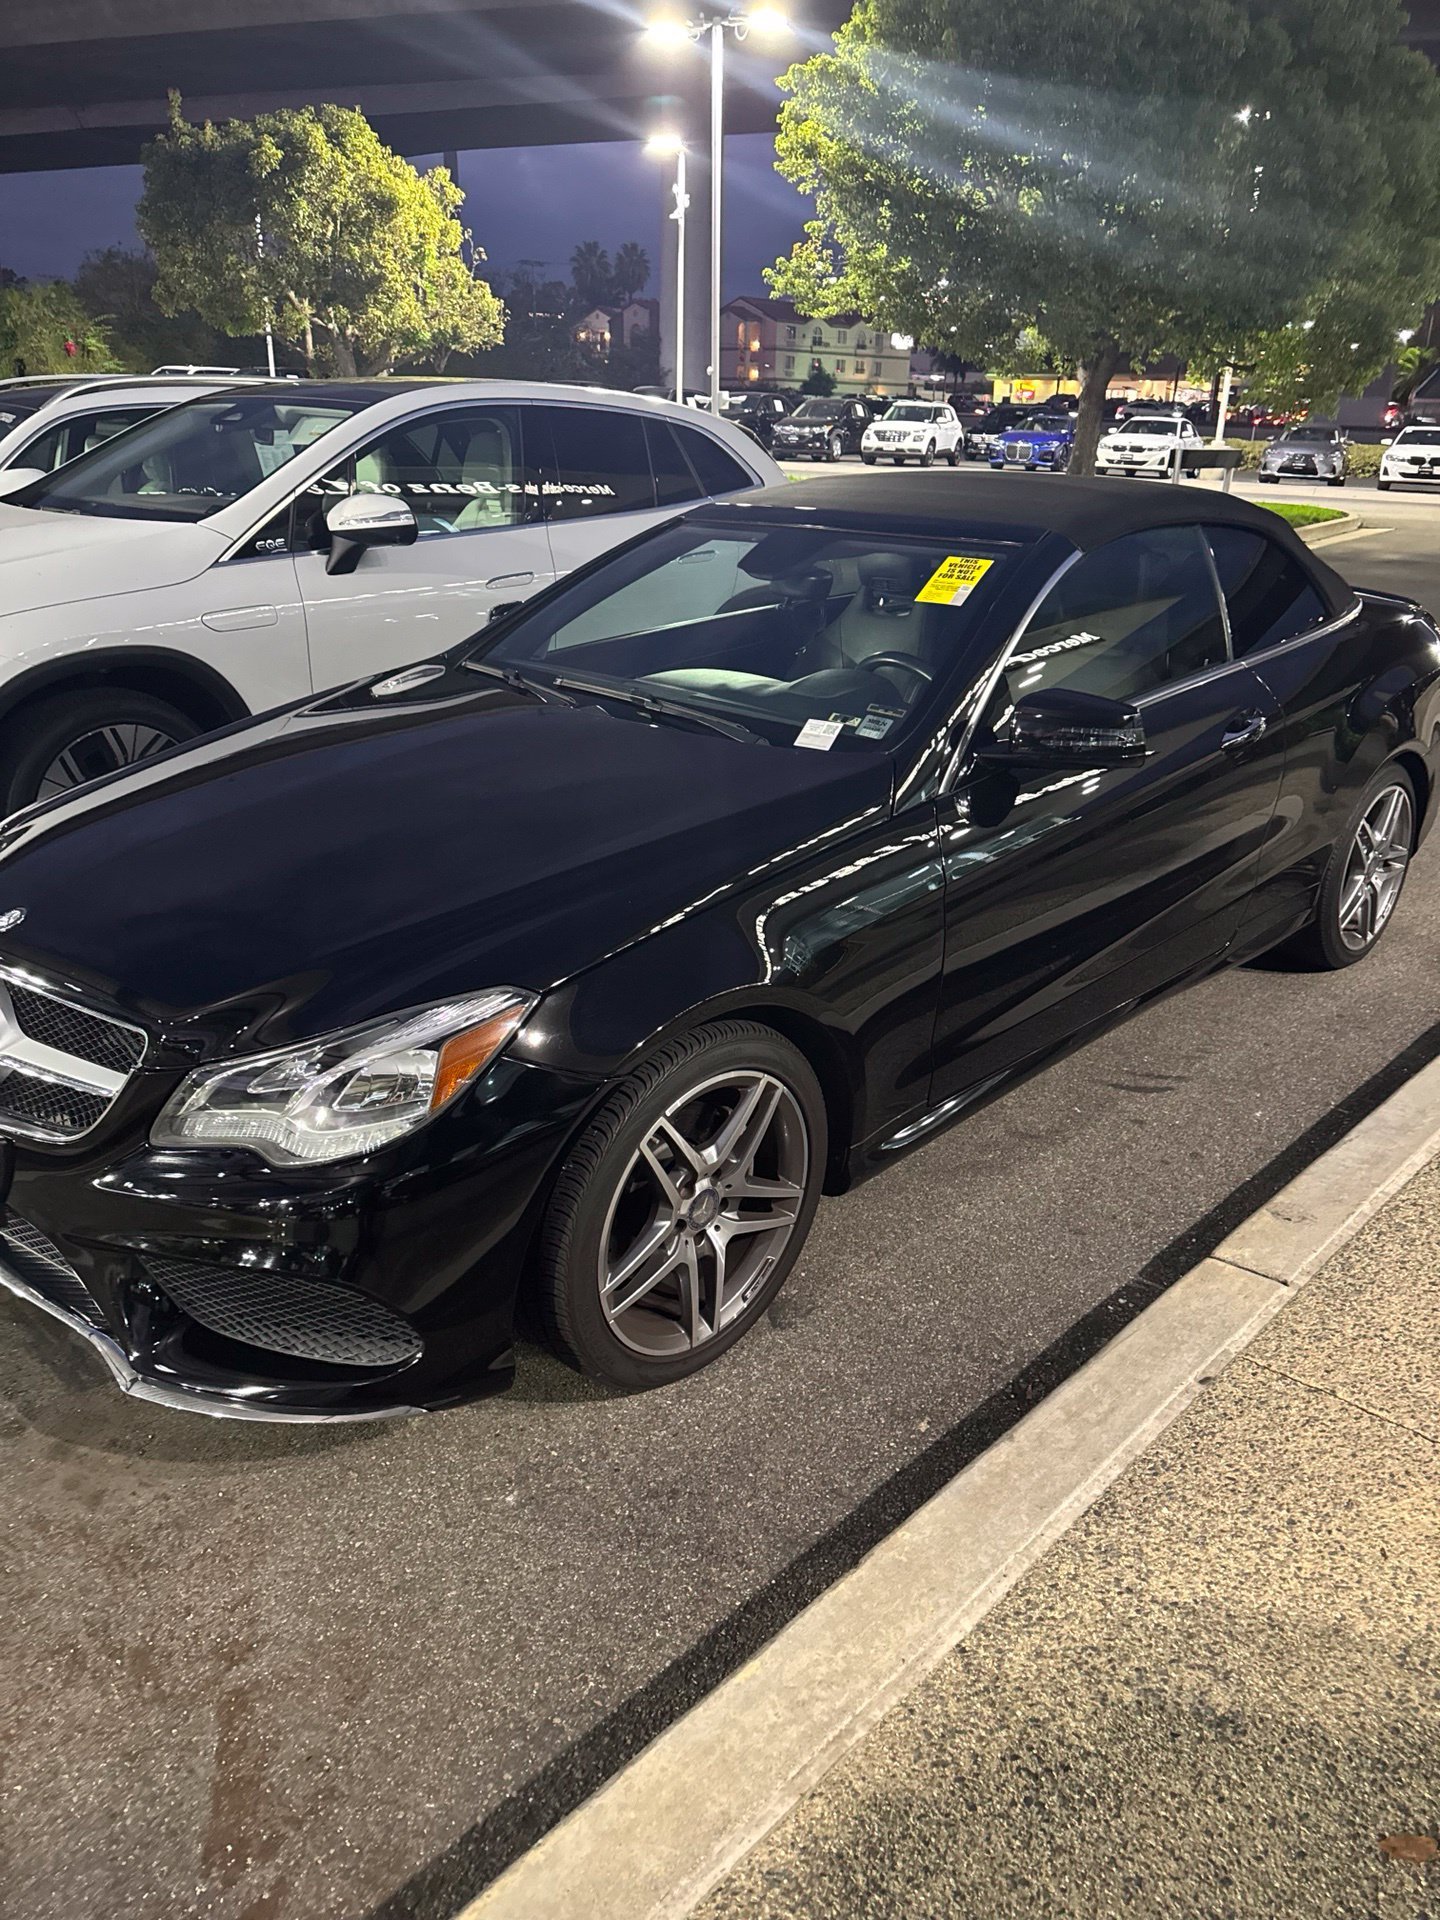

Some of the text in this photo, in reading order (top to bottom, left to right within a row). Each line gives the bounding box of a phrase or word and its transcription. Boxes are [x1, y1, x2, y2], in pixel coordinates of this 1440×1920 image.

[255, 538, 286, 551] EQE
[948, 562, 983, 571] VEHICLE
[955, 574, 977, 582] SALE
